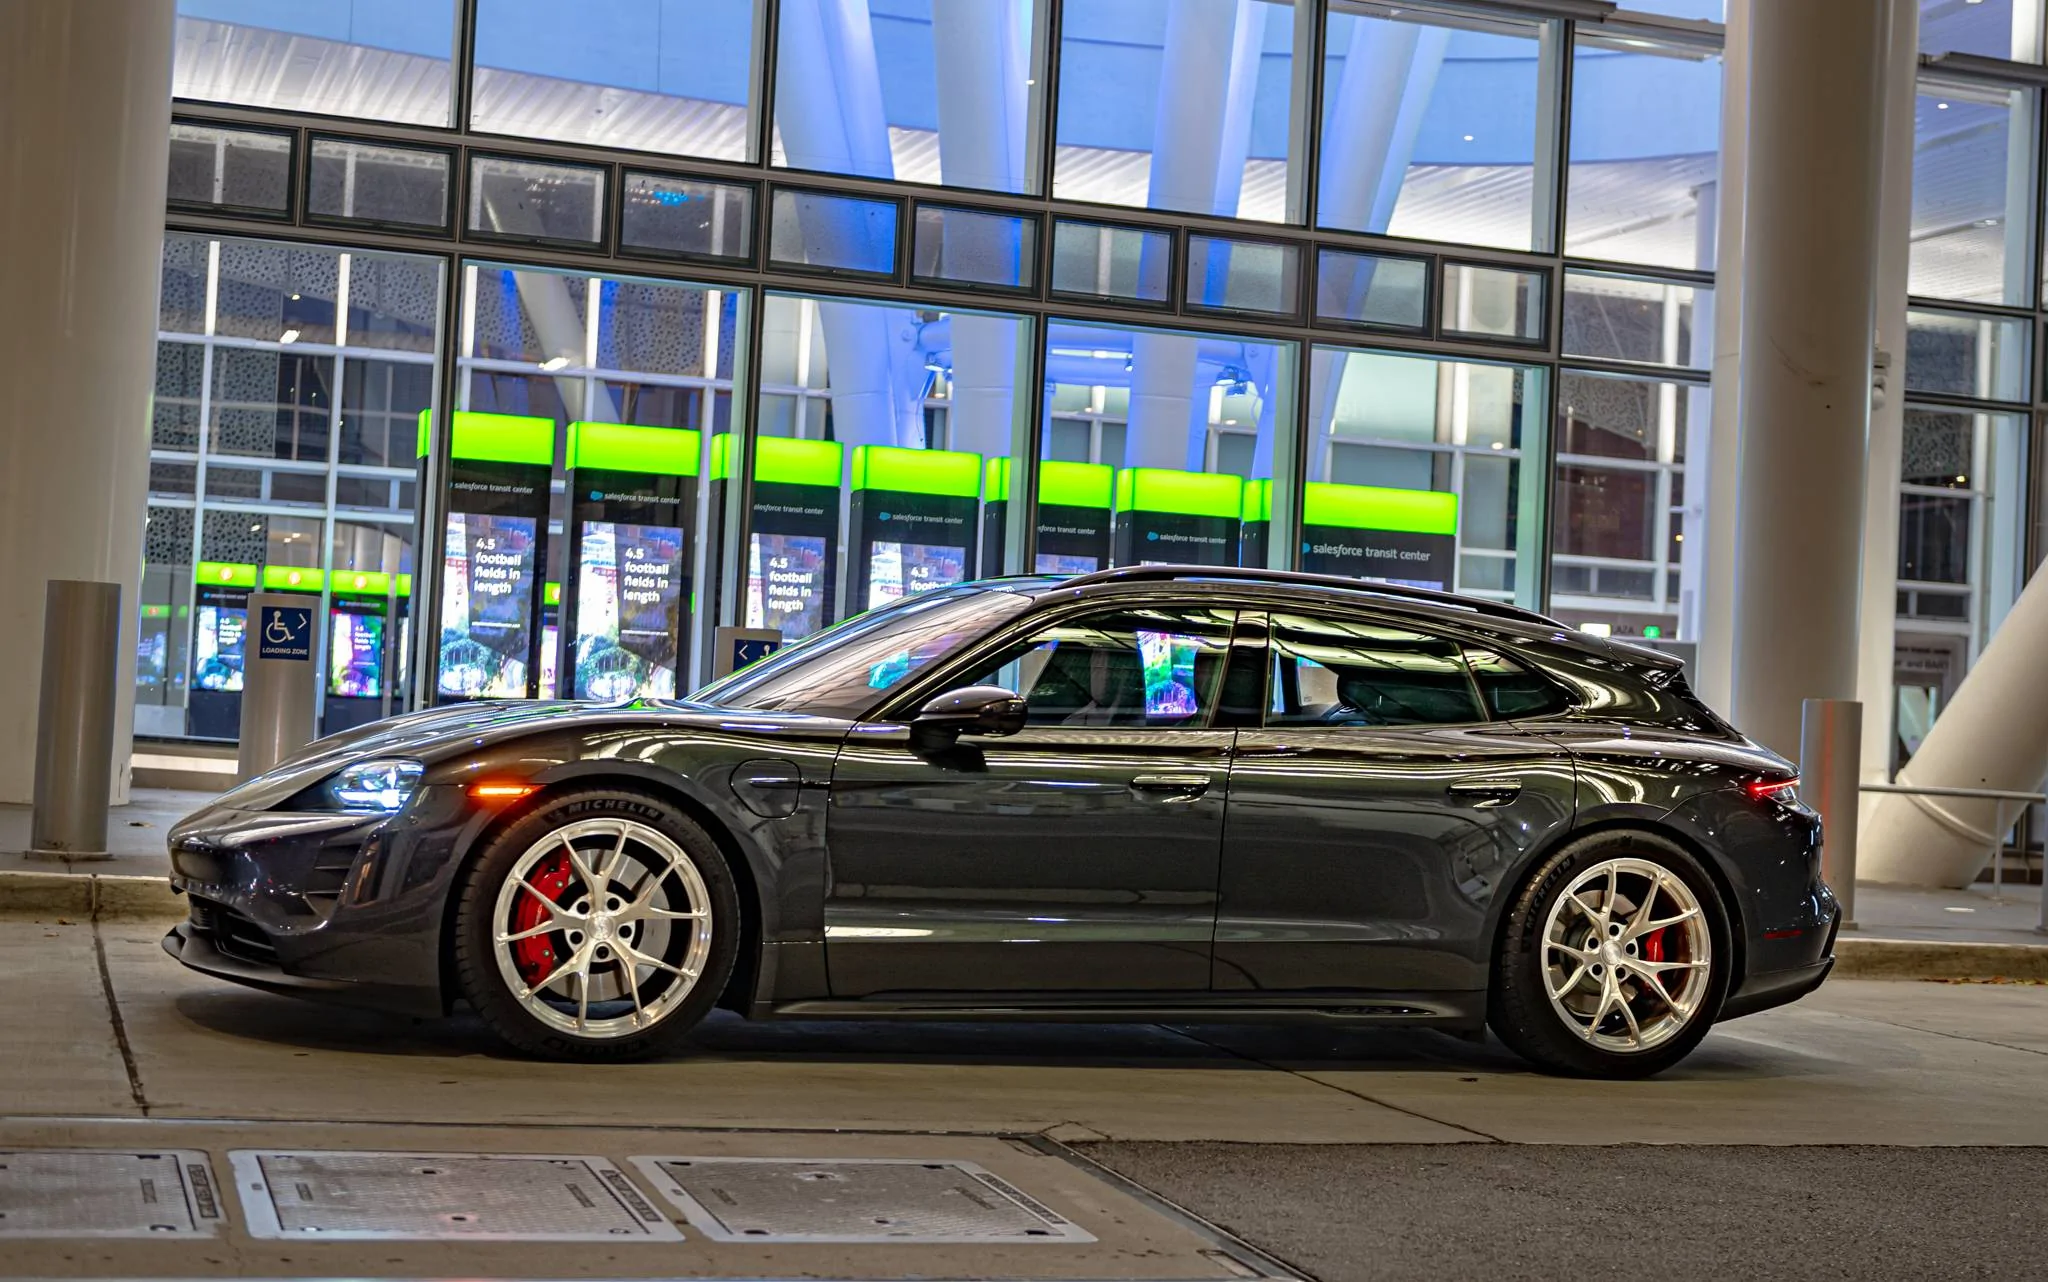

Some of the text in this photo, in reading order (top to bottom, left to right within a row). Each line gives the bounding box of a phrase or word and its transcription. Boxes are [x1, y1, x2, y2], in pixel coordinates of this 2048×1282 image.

[454, 482, 534, 494] salesforce transit center
[604, 492, 681, 504] salesforce transit center
[754, 504, 824, 515] alesforce transit center
[892, 513, 963, 525] salesforce transit center
[1057, 526, 1076, 534] transit
[476, 538, 496, 550] 4.5
[1160, 533, 1226, 544] salesforce transit center
[625, 548, 644, 560] 4.5
[1313, 543, 1431, 561] salesforce transit center
[475, 552, 521, 566] football
[769, 557, 788, 569] 4.5
[474, 566, 521, 580] fields in
[624, 561, 669, 575] football
[910, 567, 929, 578] 4.5
[624, 576, 669, 590] fields in
[769, 570, 813, 584] football
[473, 580, 512, 595] length
[768, 584, 812, 597] fields in
[623, 589, 661, 604] length
[768, 598, 804, 613] length
[262, 647, 291, 655] LOADING
[568, 799, 661, 819] MICHELIN
[1526, 858, 1571, 929] MICHELIN
